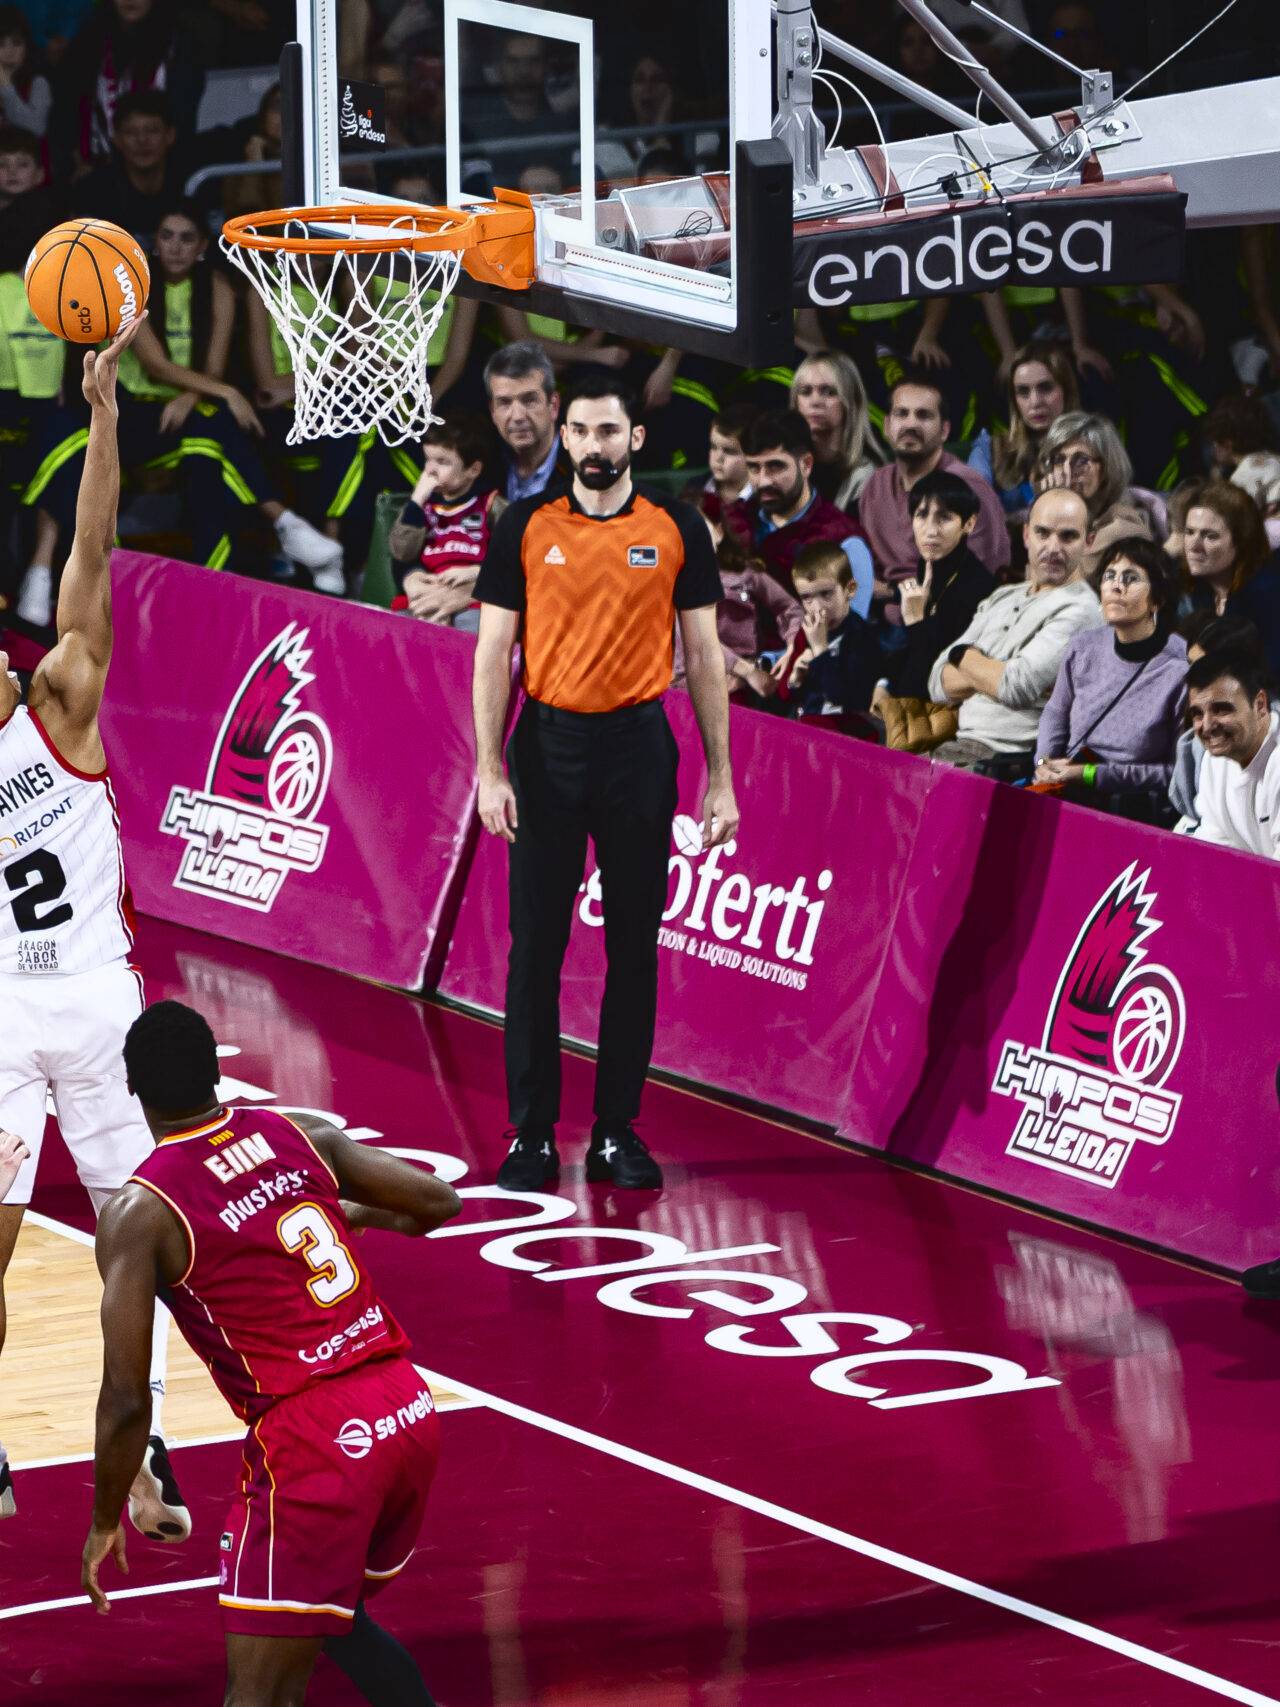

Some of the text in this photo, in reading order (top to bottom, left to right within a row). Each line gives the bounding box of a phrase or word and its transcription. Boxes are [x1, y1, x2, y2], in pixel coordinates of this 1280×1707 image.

[358, 129, 386, 143] endesa
[807, 214, 1113, 308] endesa
[77, 306, 92, 334] acb
[3, 847, 74, 933] 2
[181, 849, 282, 903] LLEIDA
[17, 950, 58, 964] SABOR
[686, 937, 698, 957] &
[698, 938, 743, 969] LIQUID
[741, 954, 809, 992] SOLUTIONS
[202, 1131, 277, 1185] EJIM
[1015, 1113, 1126, 1177] LLEIDA
[276, 1201, 360, 1309] 3
